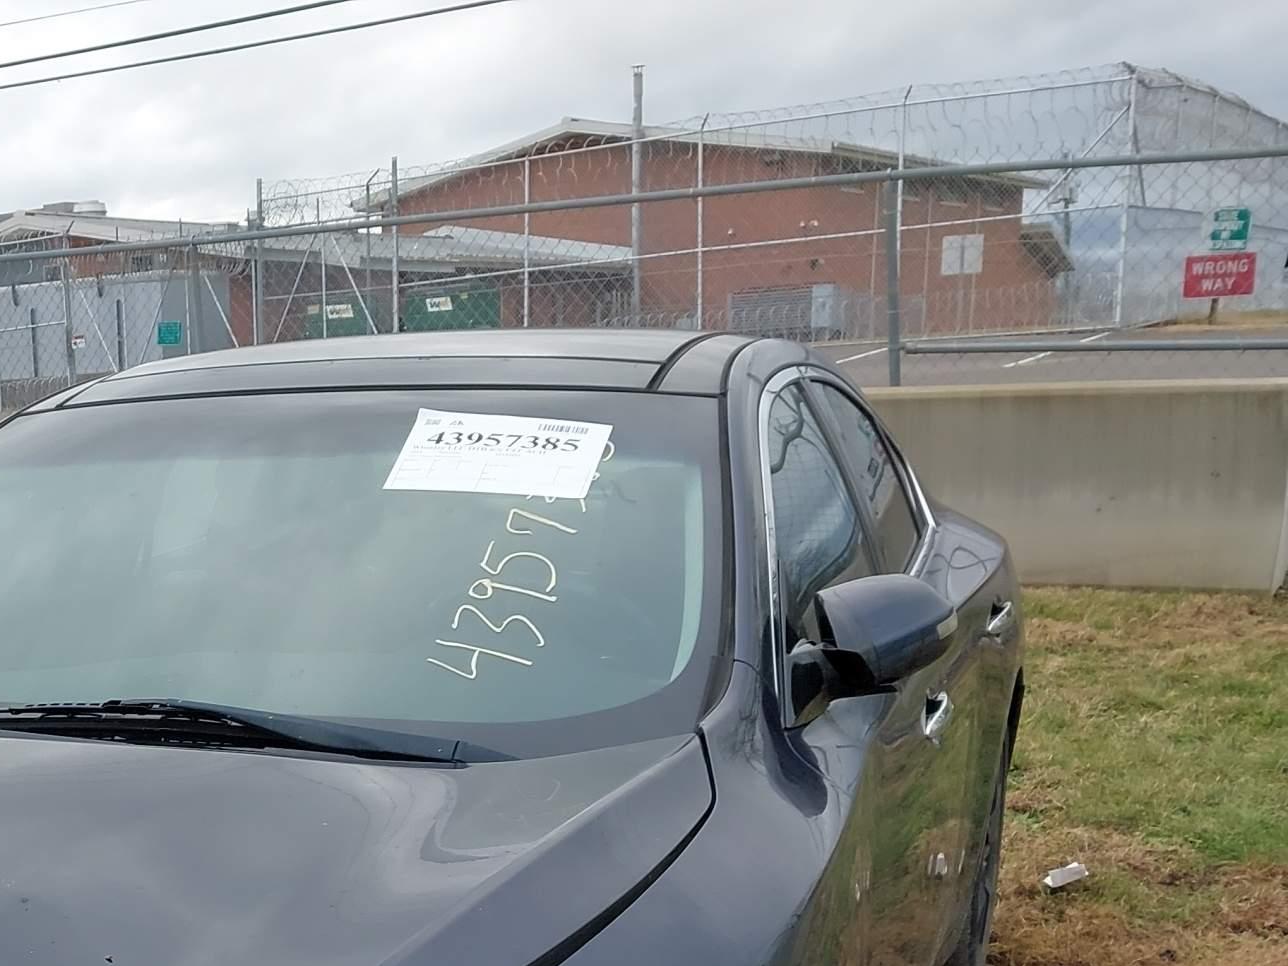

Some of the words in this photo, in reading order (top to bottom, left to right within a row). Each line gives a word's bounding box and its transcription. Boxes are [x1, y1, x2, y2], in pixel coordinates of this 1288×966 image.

[1191, 259, 1249, 276] WRONG
[1201, 277, 1235, 291] WAY
[426, 431, 581, 452] 43957385
